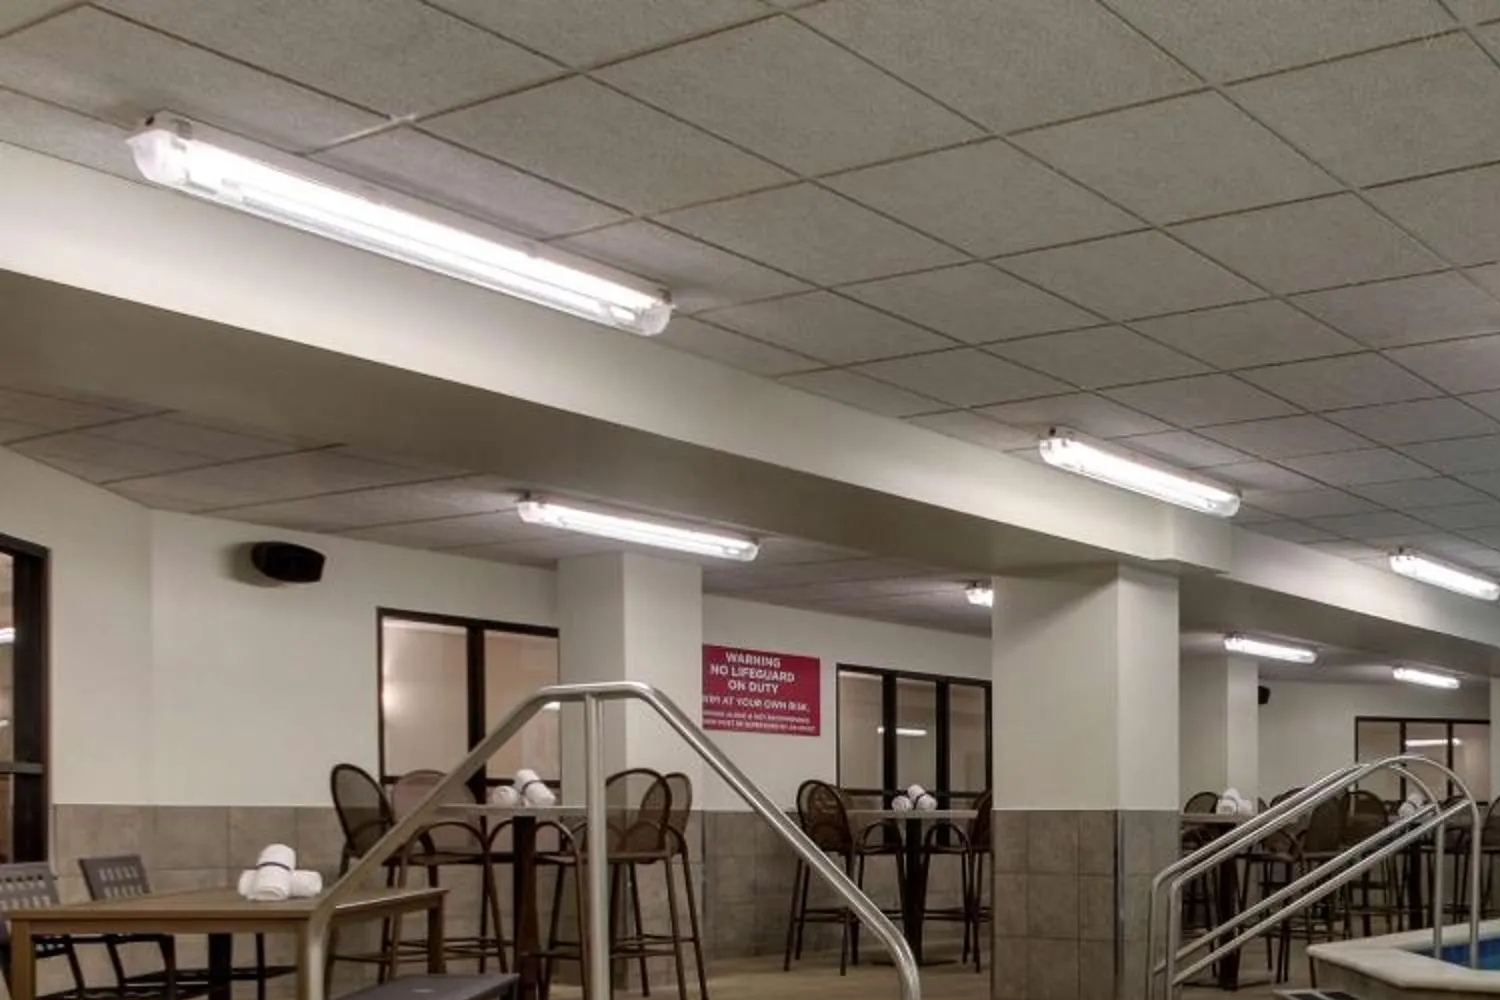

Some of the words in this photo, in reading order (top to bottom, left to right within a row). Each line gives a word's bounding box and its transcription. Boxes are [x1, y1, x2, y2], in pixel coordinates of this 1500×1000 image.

[725, 651, 781, 668] WARNING
[710, 664, 729, 676] NO
[731, 667, 795, 683] LIFEGUARD
[728, 680, 745, 691] ON
[748, 682, 779, 694] DUTY
[764, 699, 787, 710] OWN
